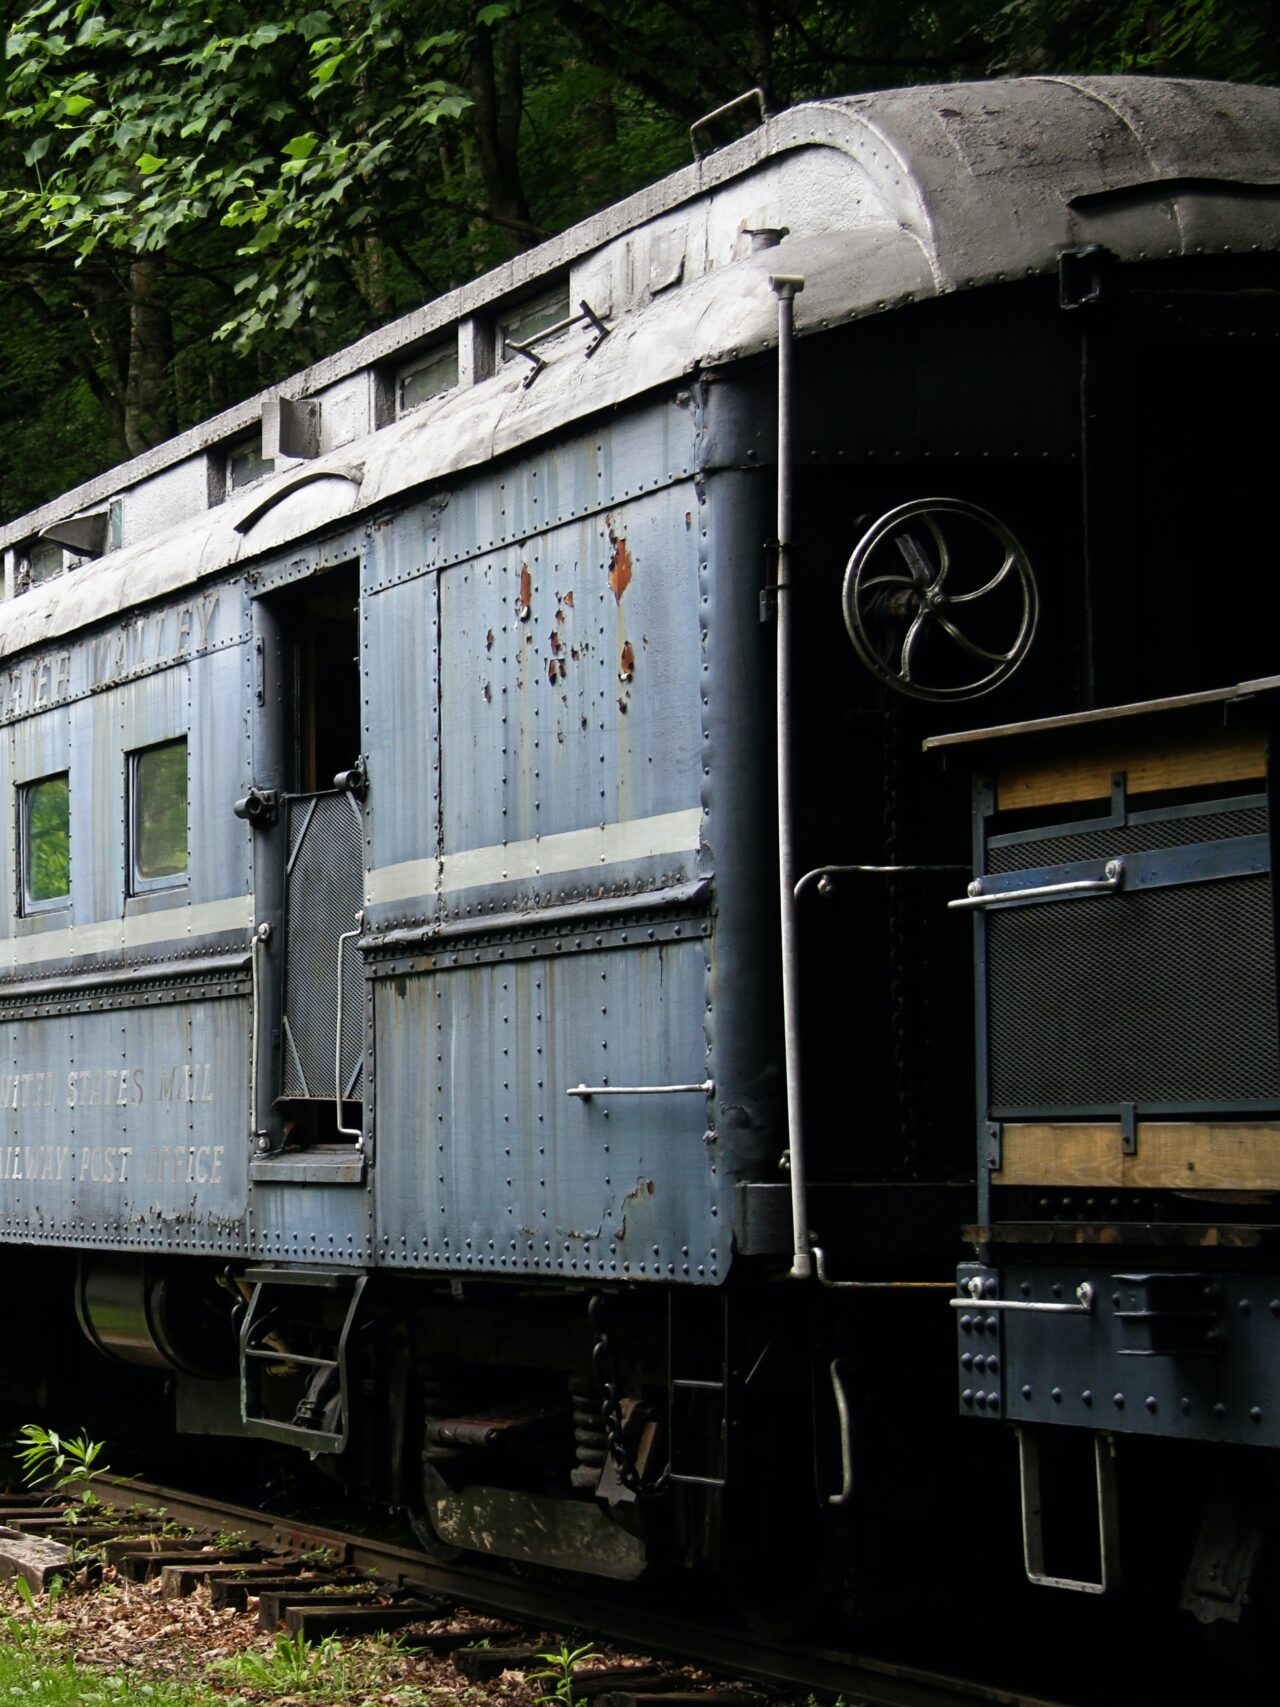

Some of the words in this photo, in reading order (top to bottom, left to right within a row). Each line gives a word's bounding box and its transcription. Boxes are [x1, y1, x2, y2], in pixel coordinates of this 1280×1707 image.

[90, 590, 219, 686] VALLEY
[67, 1069, 144, 1107] STATES
[80, 1147, 132, 1183] POST
[145, 1145, 225, 1184] OFFICE
